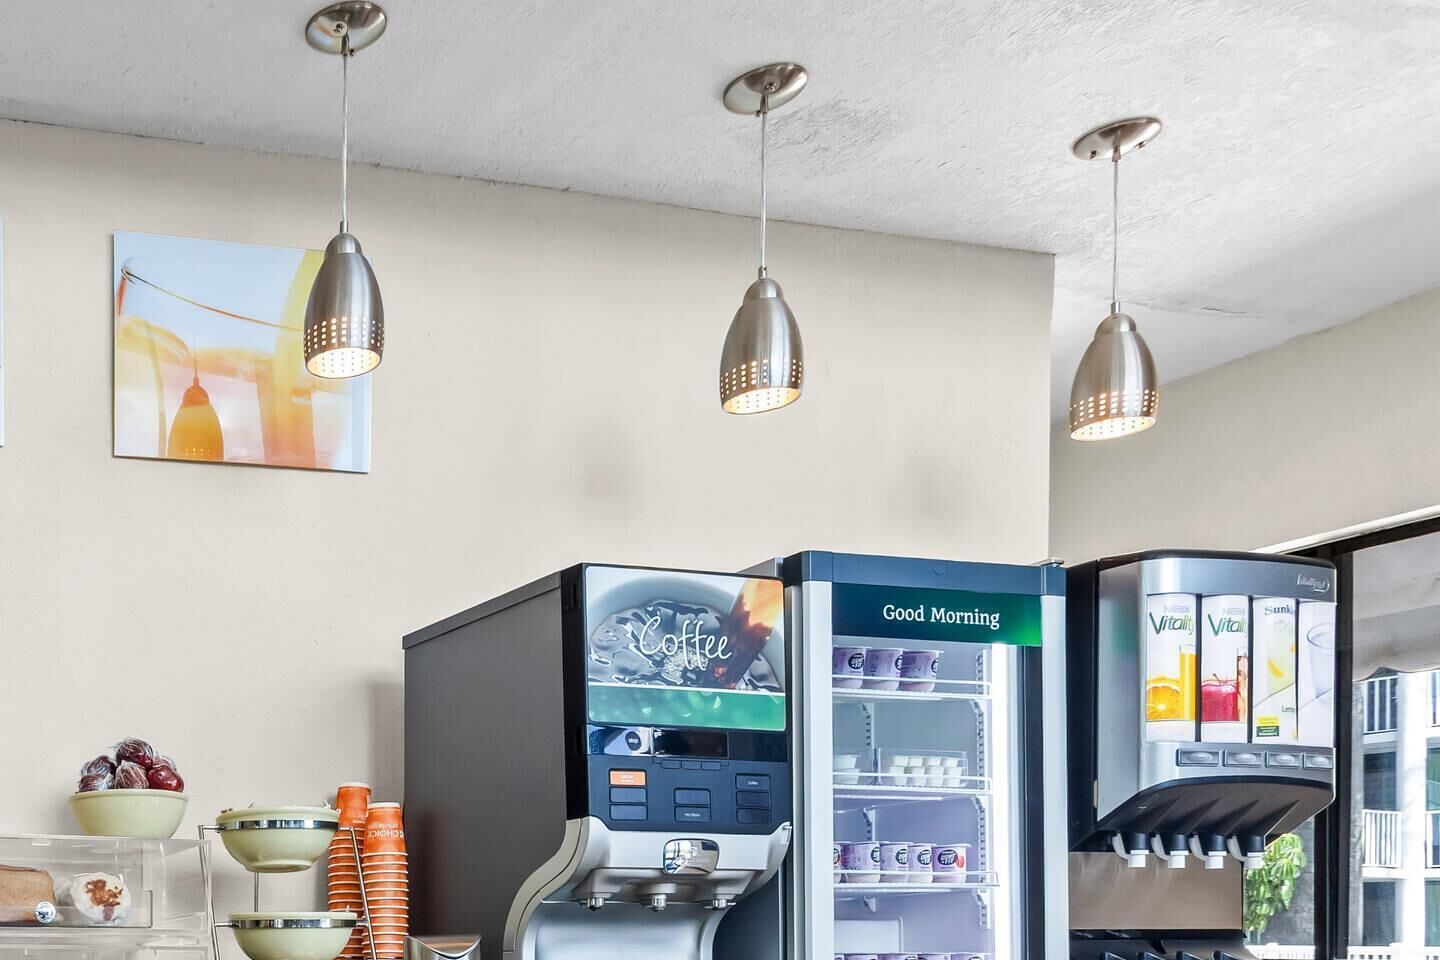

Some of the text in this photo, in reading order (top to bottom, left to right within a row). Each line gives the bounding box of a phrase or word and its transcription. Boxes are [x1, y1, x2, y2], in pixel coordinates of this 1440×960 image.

[883, 604, 1000, 630] Good Morning
[640, 615, 732, 671] Coffee
